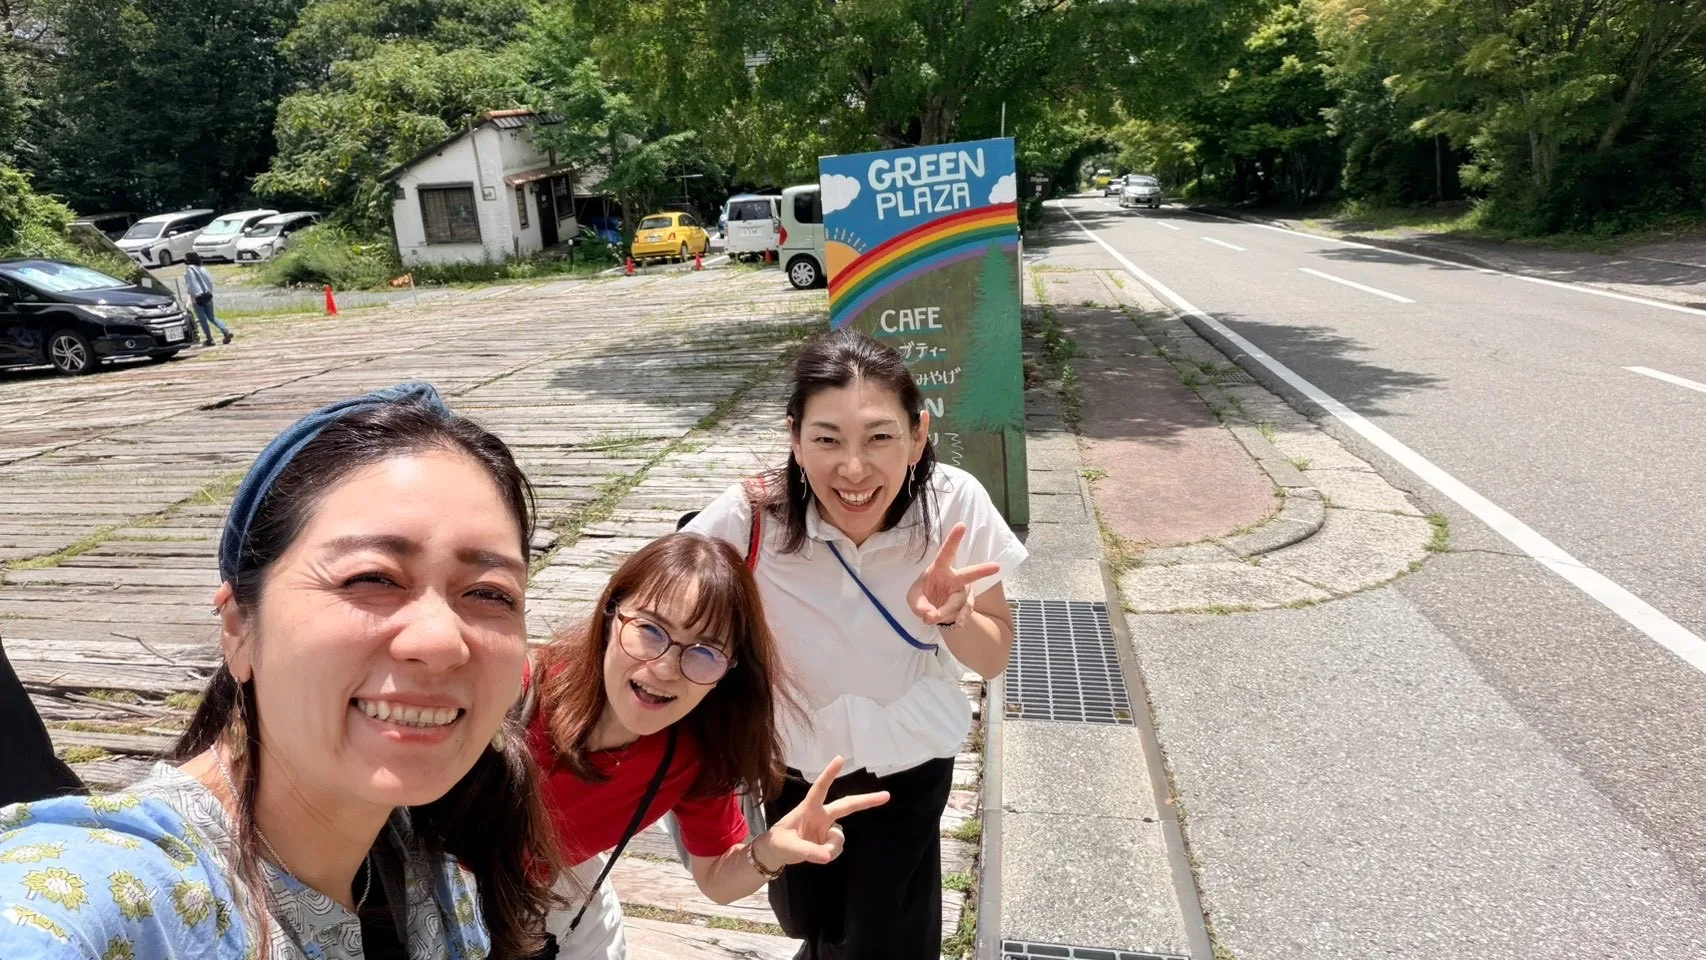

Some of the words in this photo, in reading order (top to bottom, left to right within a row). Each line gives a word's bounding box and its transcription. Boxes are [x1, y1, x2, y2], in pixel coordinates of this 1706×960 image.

[868, 147, 985, 191] GREEN
[876, 182, 971, 220] PLAZA
[880, 306, 943, 333] CAFE
[899, 340, 947, 359] ブティー
[915, 366, 962, 386] みやげ
